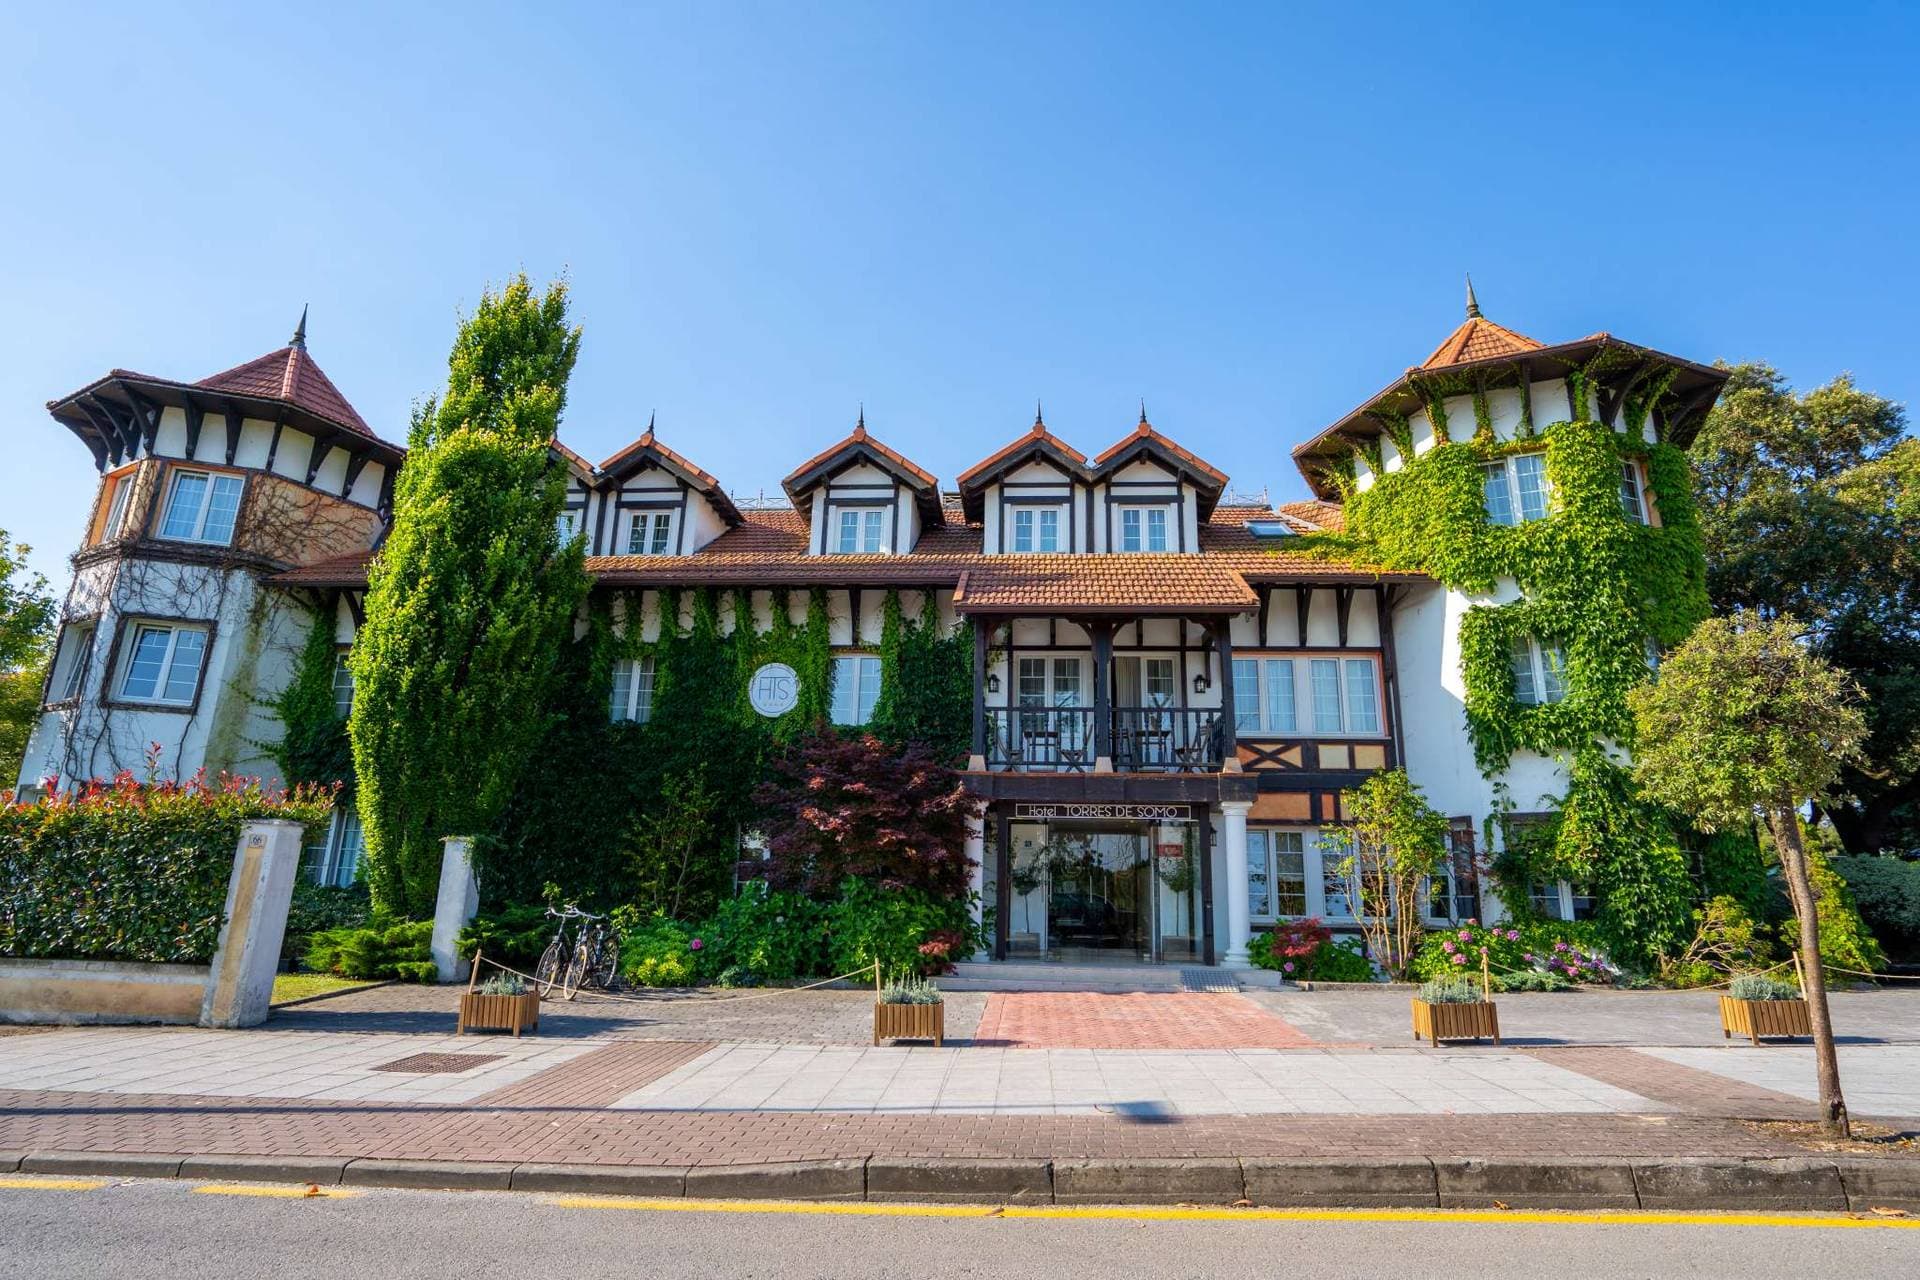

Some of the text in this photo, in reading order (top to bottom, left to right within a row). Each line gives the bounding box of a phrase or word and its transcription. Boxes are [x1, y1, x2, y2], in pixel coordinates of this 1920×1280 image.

[1029, 804, 1178, 818] Hotel TORRES DE SOMO
